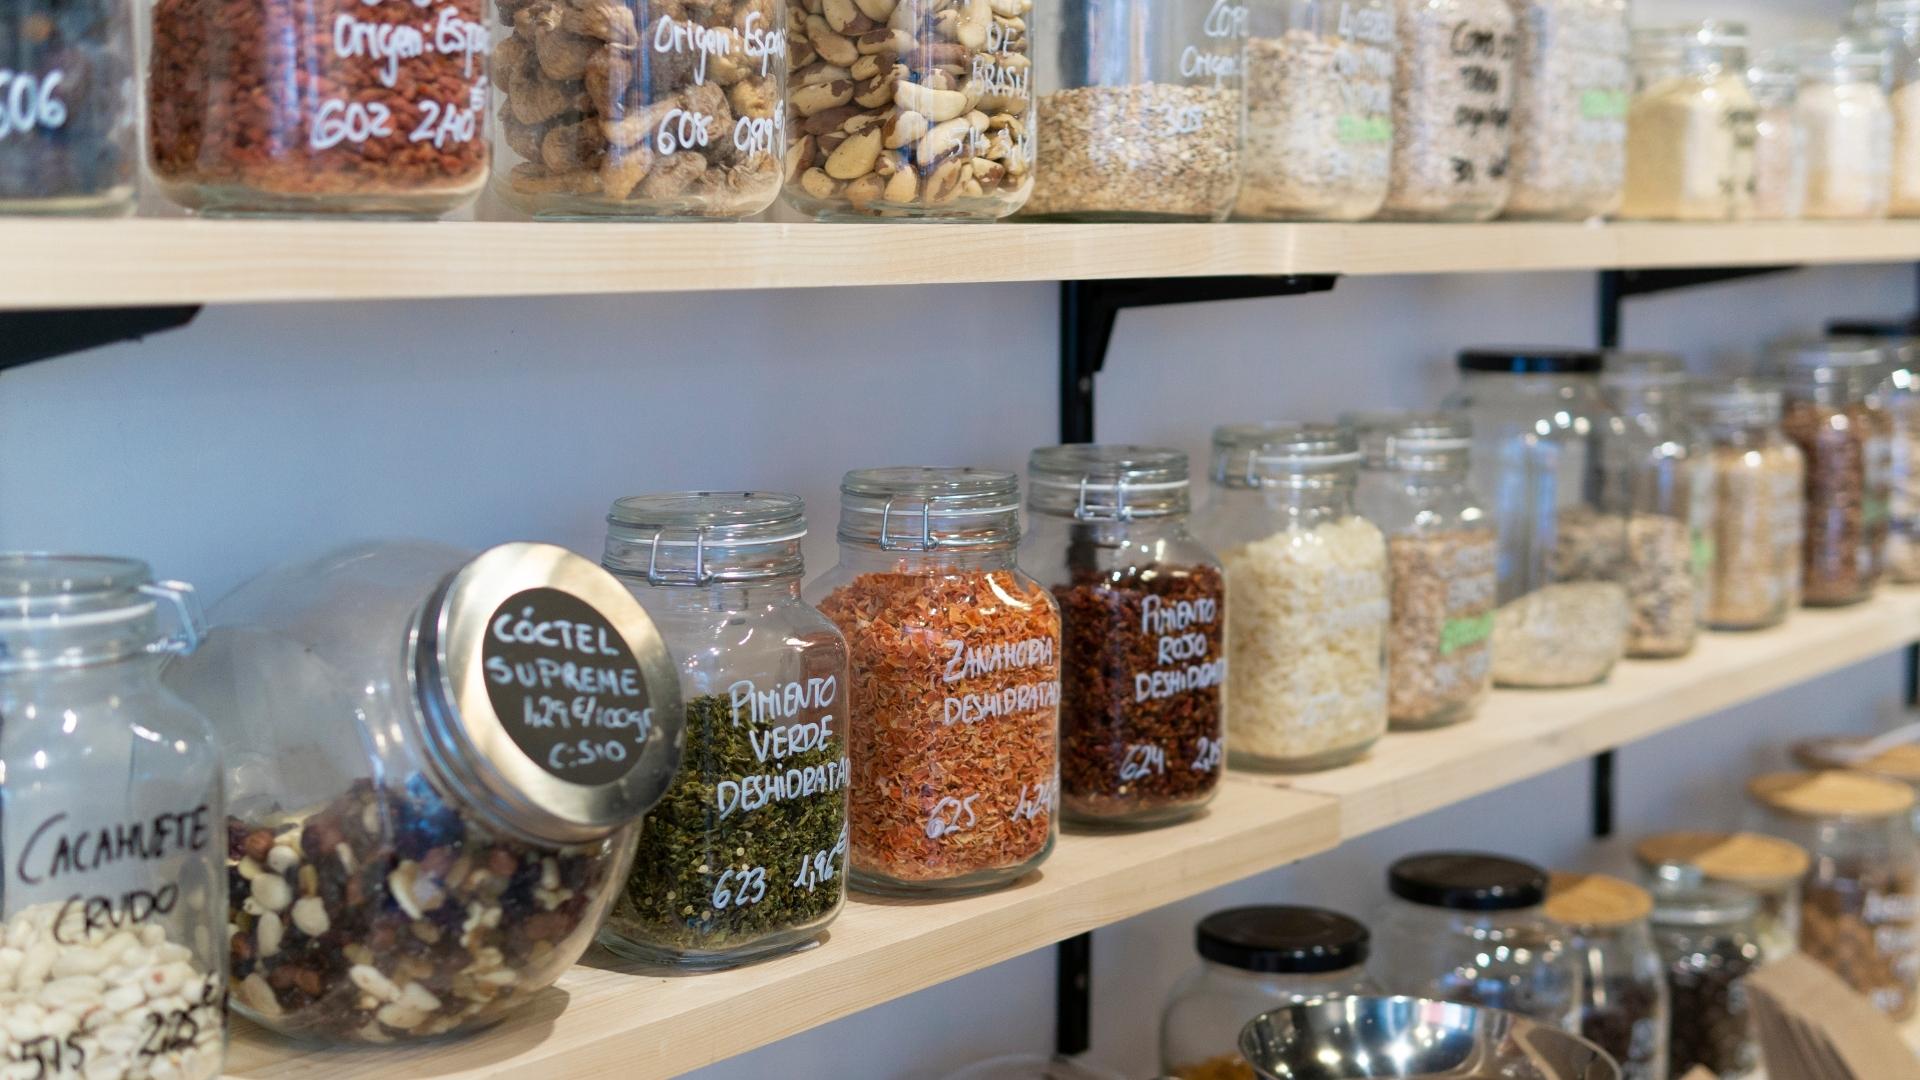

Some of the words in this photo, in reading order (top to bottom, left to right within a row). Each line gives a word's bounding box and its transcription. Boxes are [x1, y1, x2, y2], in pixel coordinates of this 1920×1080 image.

[986, 20, 1017, 57] DE
[972, 54, 1029, 100] BRASIL
[311, 99, 393, 149] 602
[657, 108, 713, 155] 608
[493, 606, 619, 656] CÓCTEL
[1141, 594, 1216, 635] PIMIENTO
[943, 637, 1053, 683] ZANAHORIA
[1158, 633, 1208, 665] ROJO
[486, 655, 641, 696] SUPREME
[749, 714, 833, 763] VERDE
[1120, 745, 1164, 780] 624
[926, 792, 981, 839] 625
[18, 804, 208, 884] CACAHUETE
[712, 867, 766, 909] 623
[54, 882, 179, 945] CRUDO
